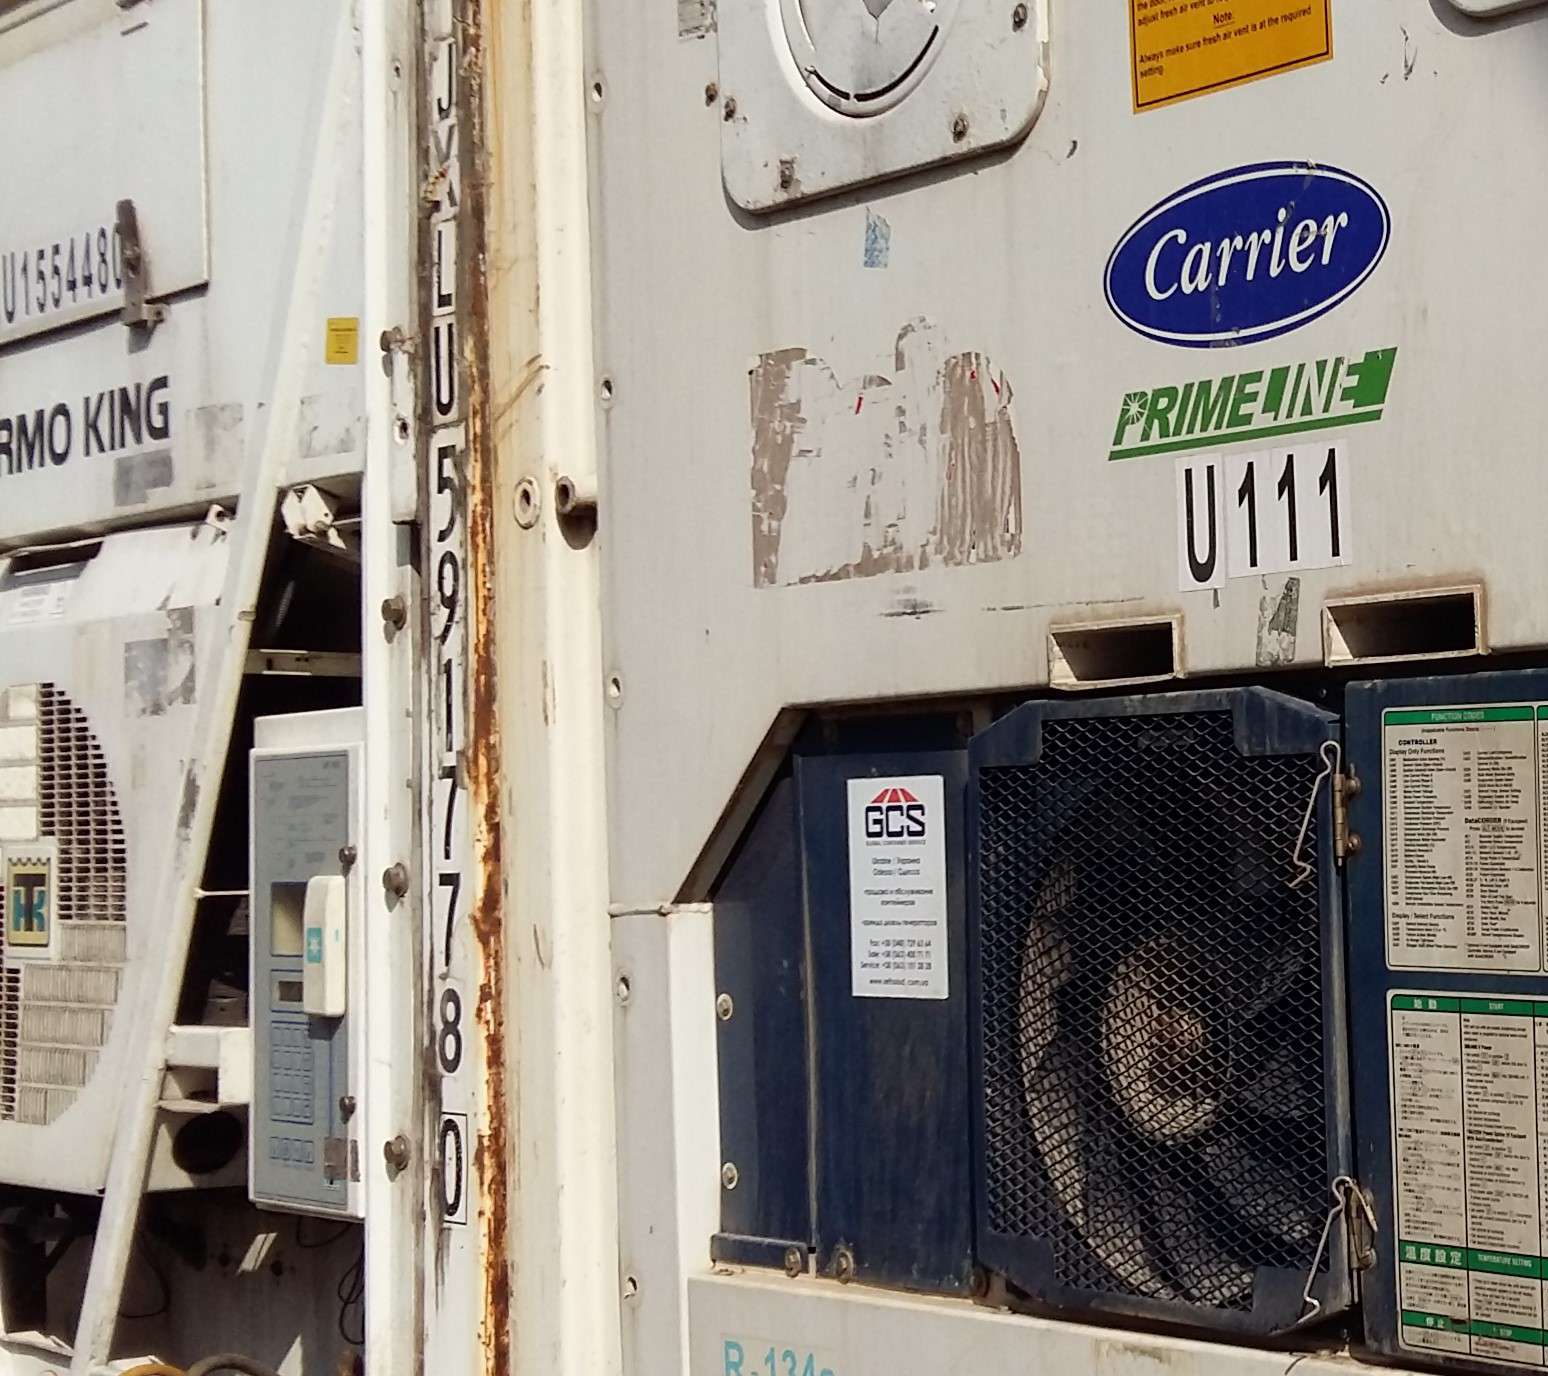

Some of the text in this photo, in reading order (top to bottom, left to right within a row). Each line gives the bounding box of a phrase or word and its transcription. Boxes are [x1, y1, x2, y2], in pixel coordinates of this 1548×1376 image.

[1143, 208, 1349, 303] Carrier
[82, 374, 171, 458] KING
[1111, 348, 1372, 447] PRIMELINE
[1184, 447, 1342, 584] U111
[436, 444, 462, 1075] 591778
[1398, 738, 1438, 746] CONTROLLER
[865, 804, 926, 839] GCS
[440, 1117, 463, 1217] 0
